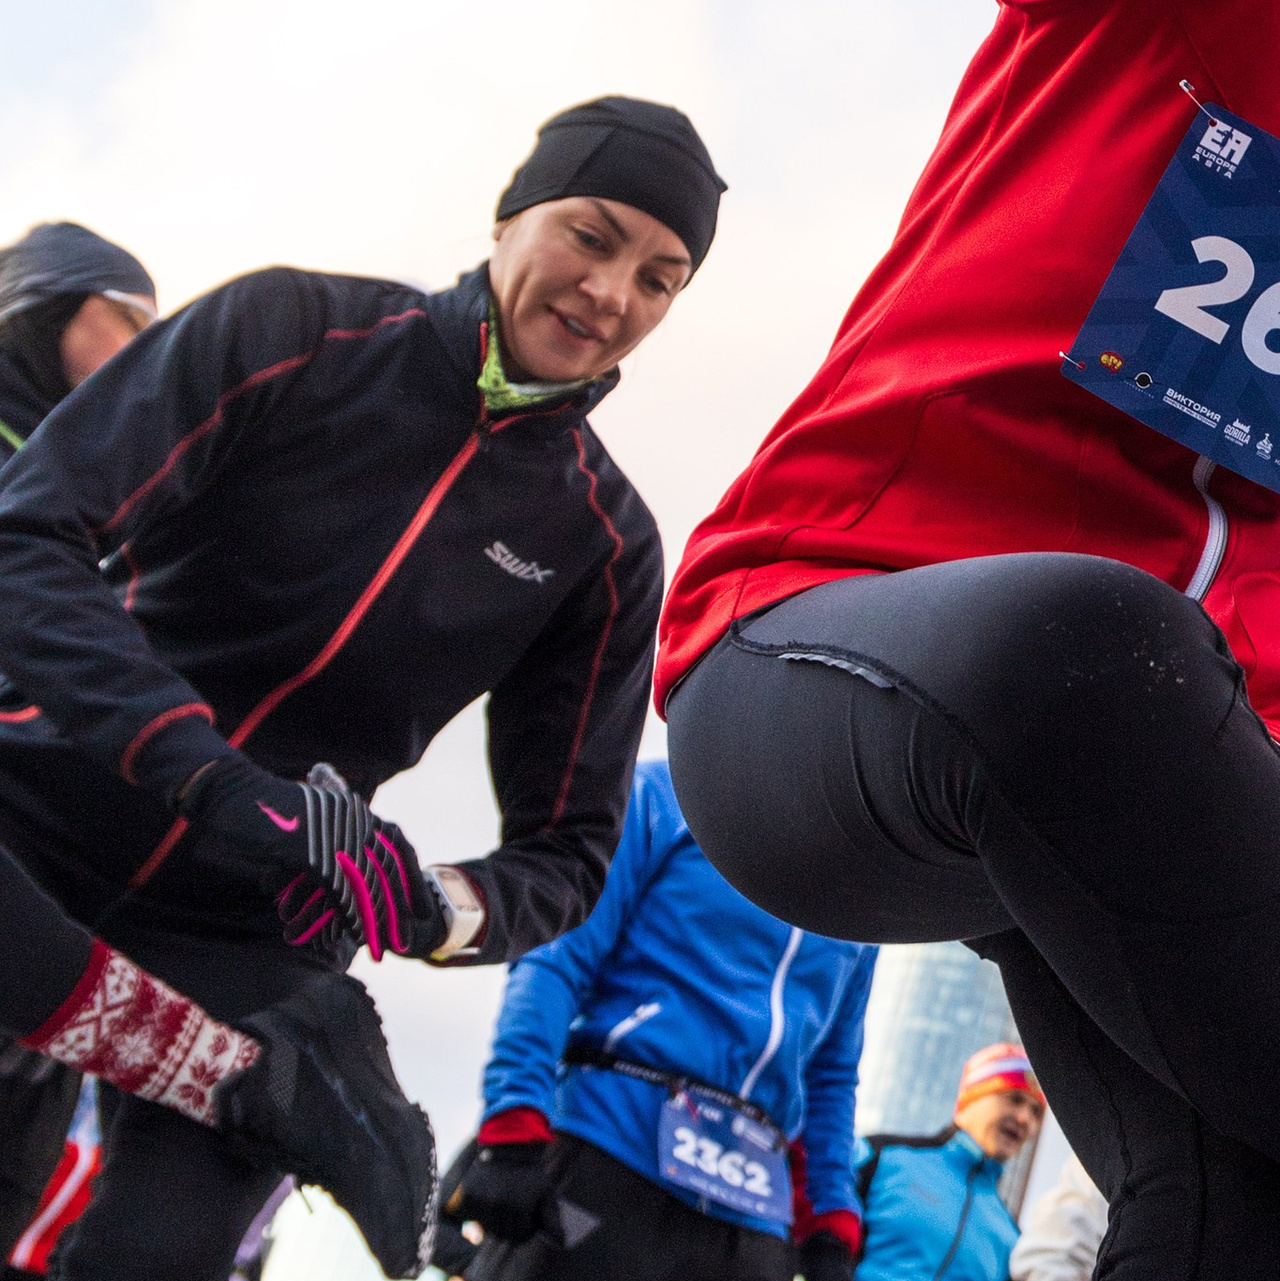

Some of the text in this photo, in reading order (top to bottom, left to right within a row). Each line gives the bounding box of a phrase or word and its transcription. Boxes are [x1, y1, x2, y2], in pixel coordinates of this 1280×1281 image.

[1192, 153, 1232, 179] ASIA
[1195, 146, 1237, 172] EUROPE
[1166, 388, 1221, 423] ВИКТОРИЯ
[1223, 424, 1250, 445] GORILLA
[673, 1126, 773, 1197] 2362
